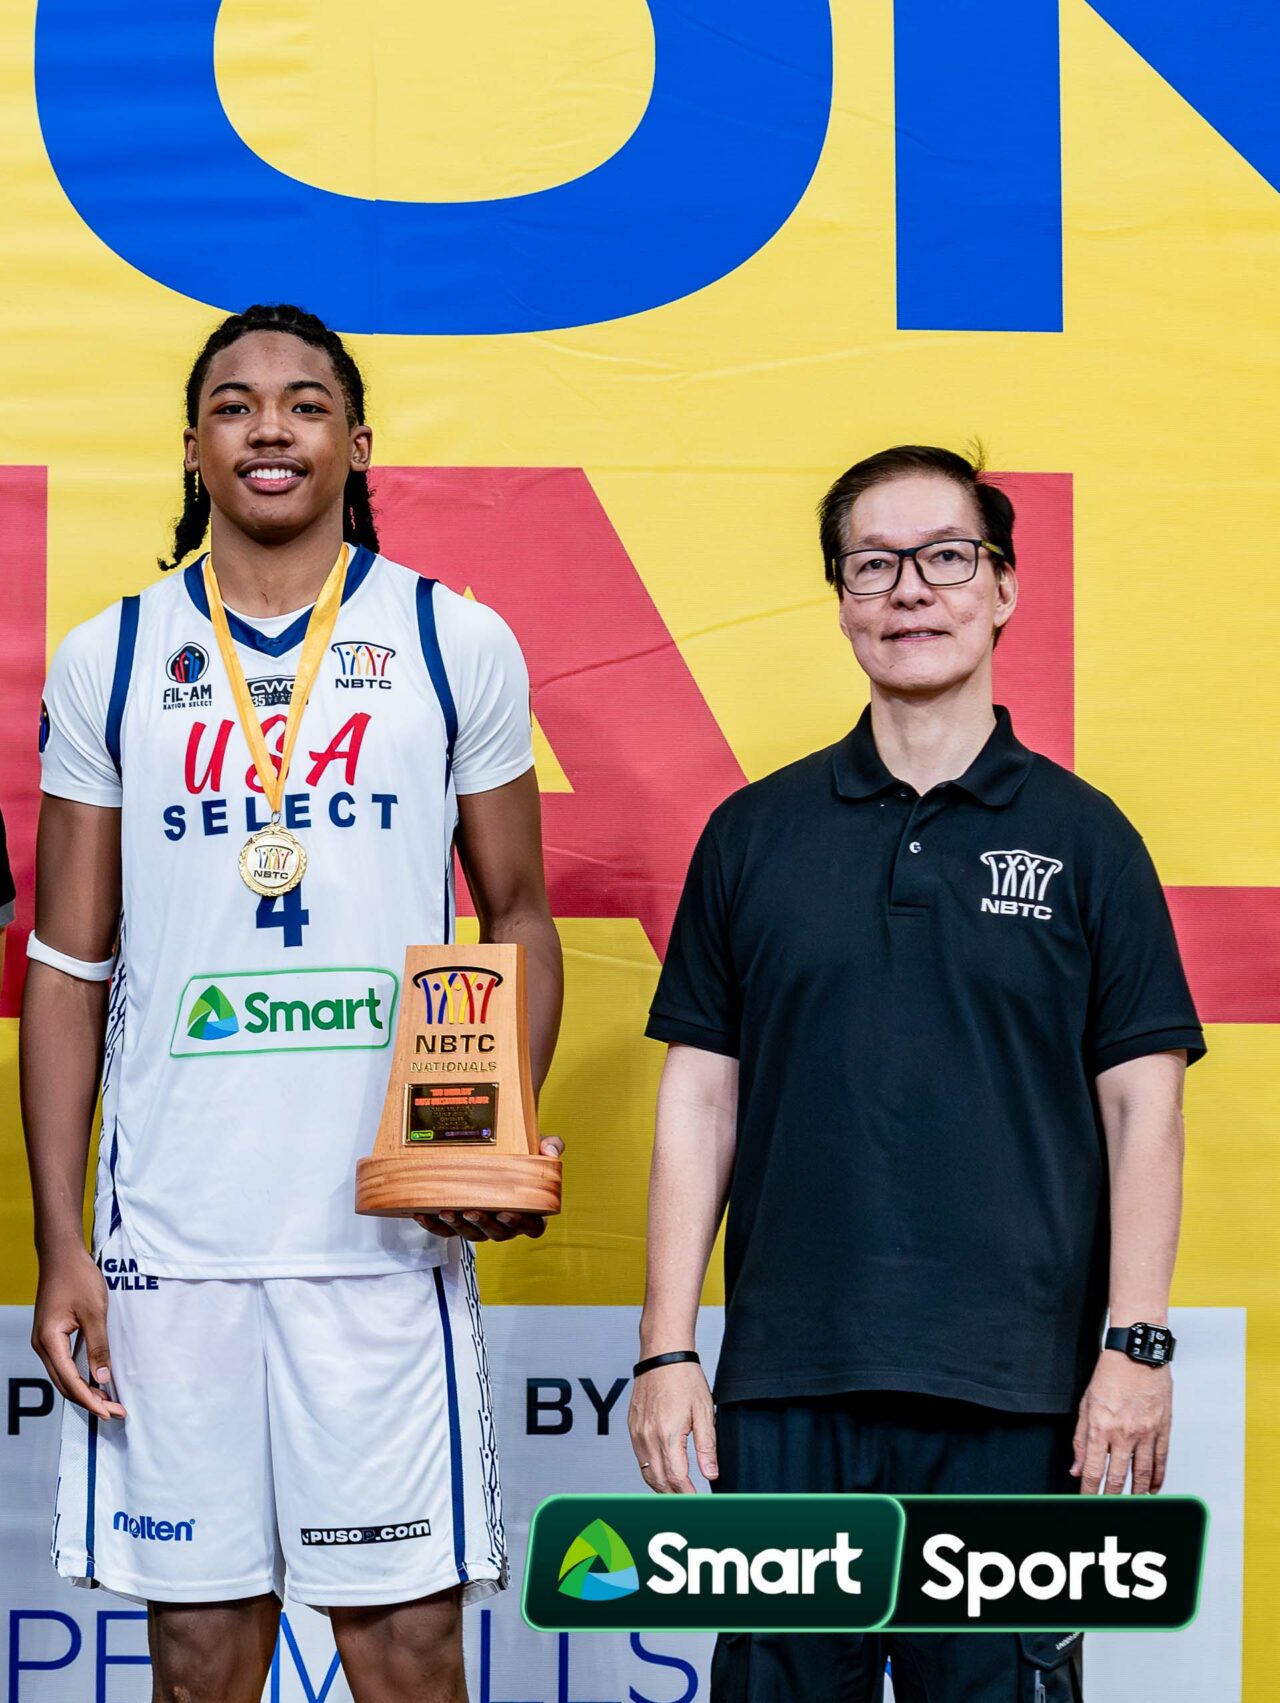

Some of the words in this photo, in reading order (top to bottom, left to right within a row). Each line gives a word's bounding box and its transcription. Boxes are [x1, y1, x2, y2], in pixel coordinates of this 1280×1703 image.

[163, 684, 212, 703] FIL-AM
[335, 678, 392, 690] NBTC
[184, 712, 372, 794] USA
[163, 793, 398, 841] SELECT
[253, 870, 289, 880] NBTC
[256, 881, 309, 948] 4
[980, 898, 1053, 920] NBTC
[244, 987, 383, 1034] Smart
[415, 1033, 496, 1054] NBTC
[410, 1061, 497, 1073] NATIONALS
[104, 1275, 159, 1290] VILLE
[526, 1377, 631, 1435] BY
